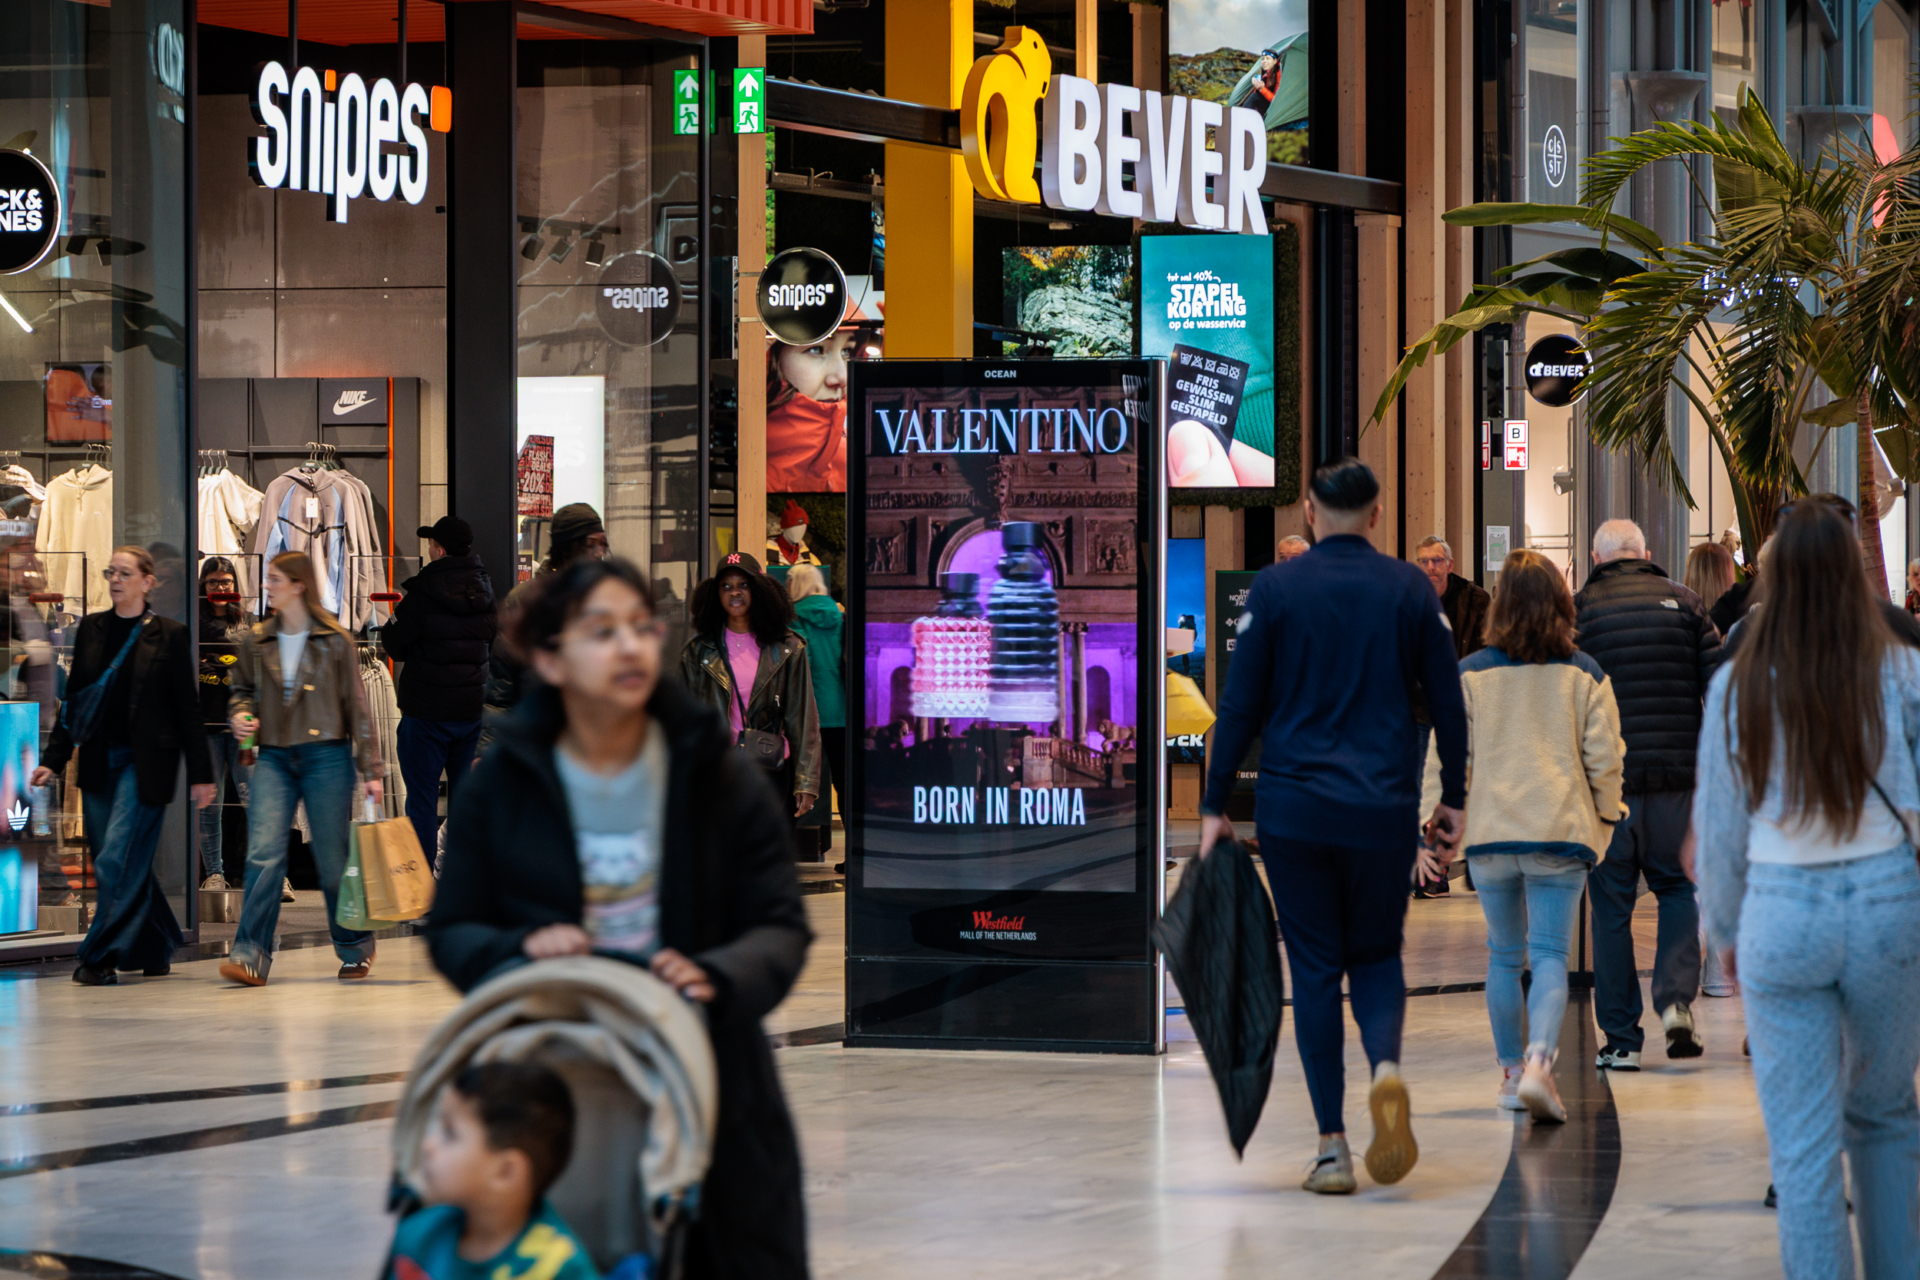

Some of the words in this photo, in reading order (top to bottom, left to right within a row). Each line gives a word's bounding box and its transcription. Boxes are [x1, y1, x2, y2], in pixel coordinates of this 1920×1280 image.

[257, 61, 429, 224] snipes
[1058, 73, 1269, 236] BEVER
[1193, 270, 1213, 282] 40%
[768, 284, 826, 311] snipes
[1170, 283, 1244, 304] STAPEL
[1167, 299, 1247, 319] KORTING
[1169, 320, 1181, 332] op
[1182, 318, 1195, 329] de
[1196, 317, 1247, 329] wasservice
[984, 369, 1017, 379] OCEAN
[1543, 364, 1585, 377] BEVER
[1195, 373, 1220, 390] FRIS
[339, 390, 367, 404] NIKE
[1175, 379, 1234, 406] GEWASSEN
[1188, 394, 1215, 411] SLIM
[1170, 399, 1228, 426] GESTAPELD
[875, 408, 1128, 454] VALENTINO
[1512, 427, 1521, 439] B
[528, 449, 549, 462] FLASH
[531, 460, 552, 472] DEALS
[1240, 771, 1259, 779] BEVE
[914, 786, 975, 824] BORN
[986, 786, 1009, 825] IN
[1020, 786, 1086, 826] ROMA
[972, 910, 1026, 931] Westfield
[960, 931, 975, 940] MALL
[975, 931, 984, 940] OF
[984, 931, 995, 940] THE
[996, 931, 1037, 941] NETHERLANDS
